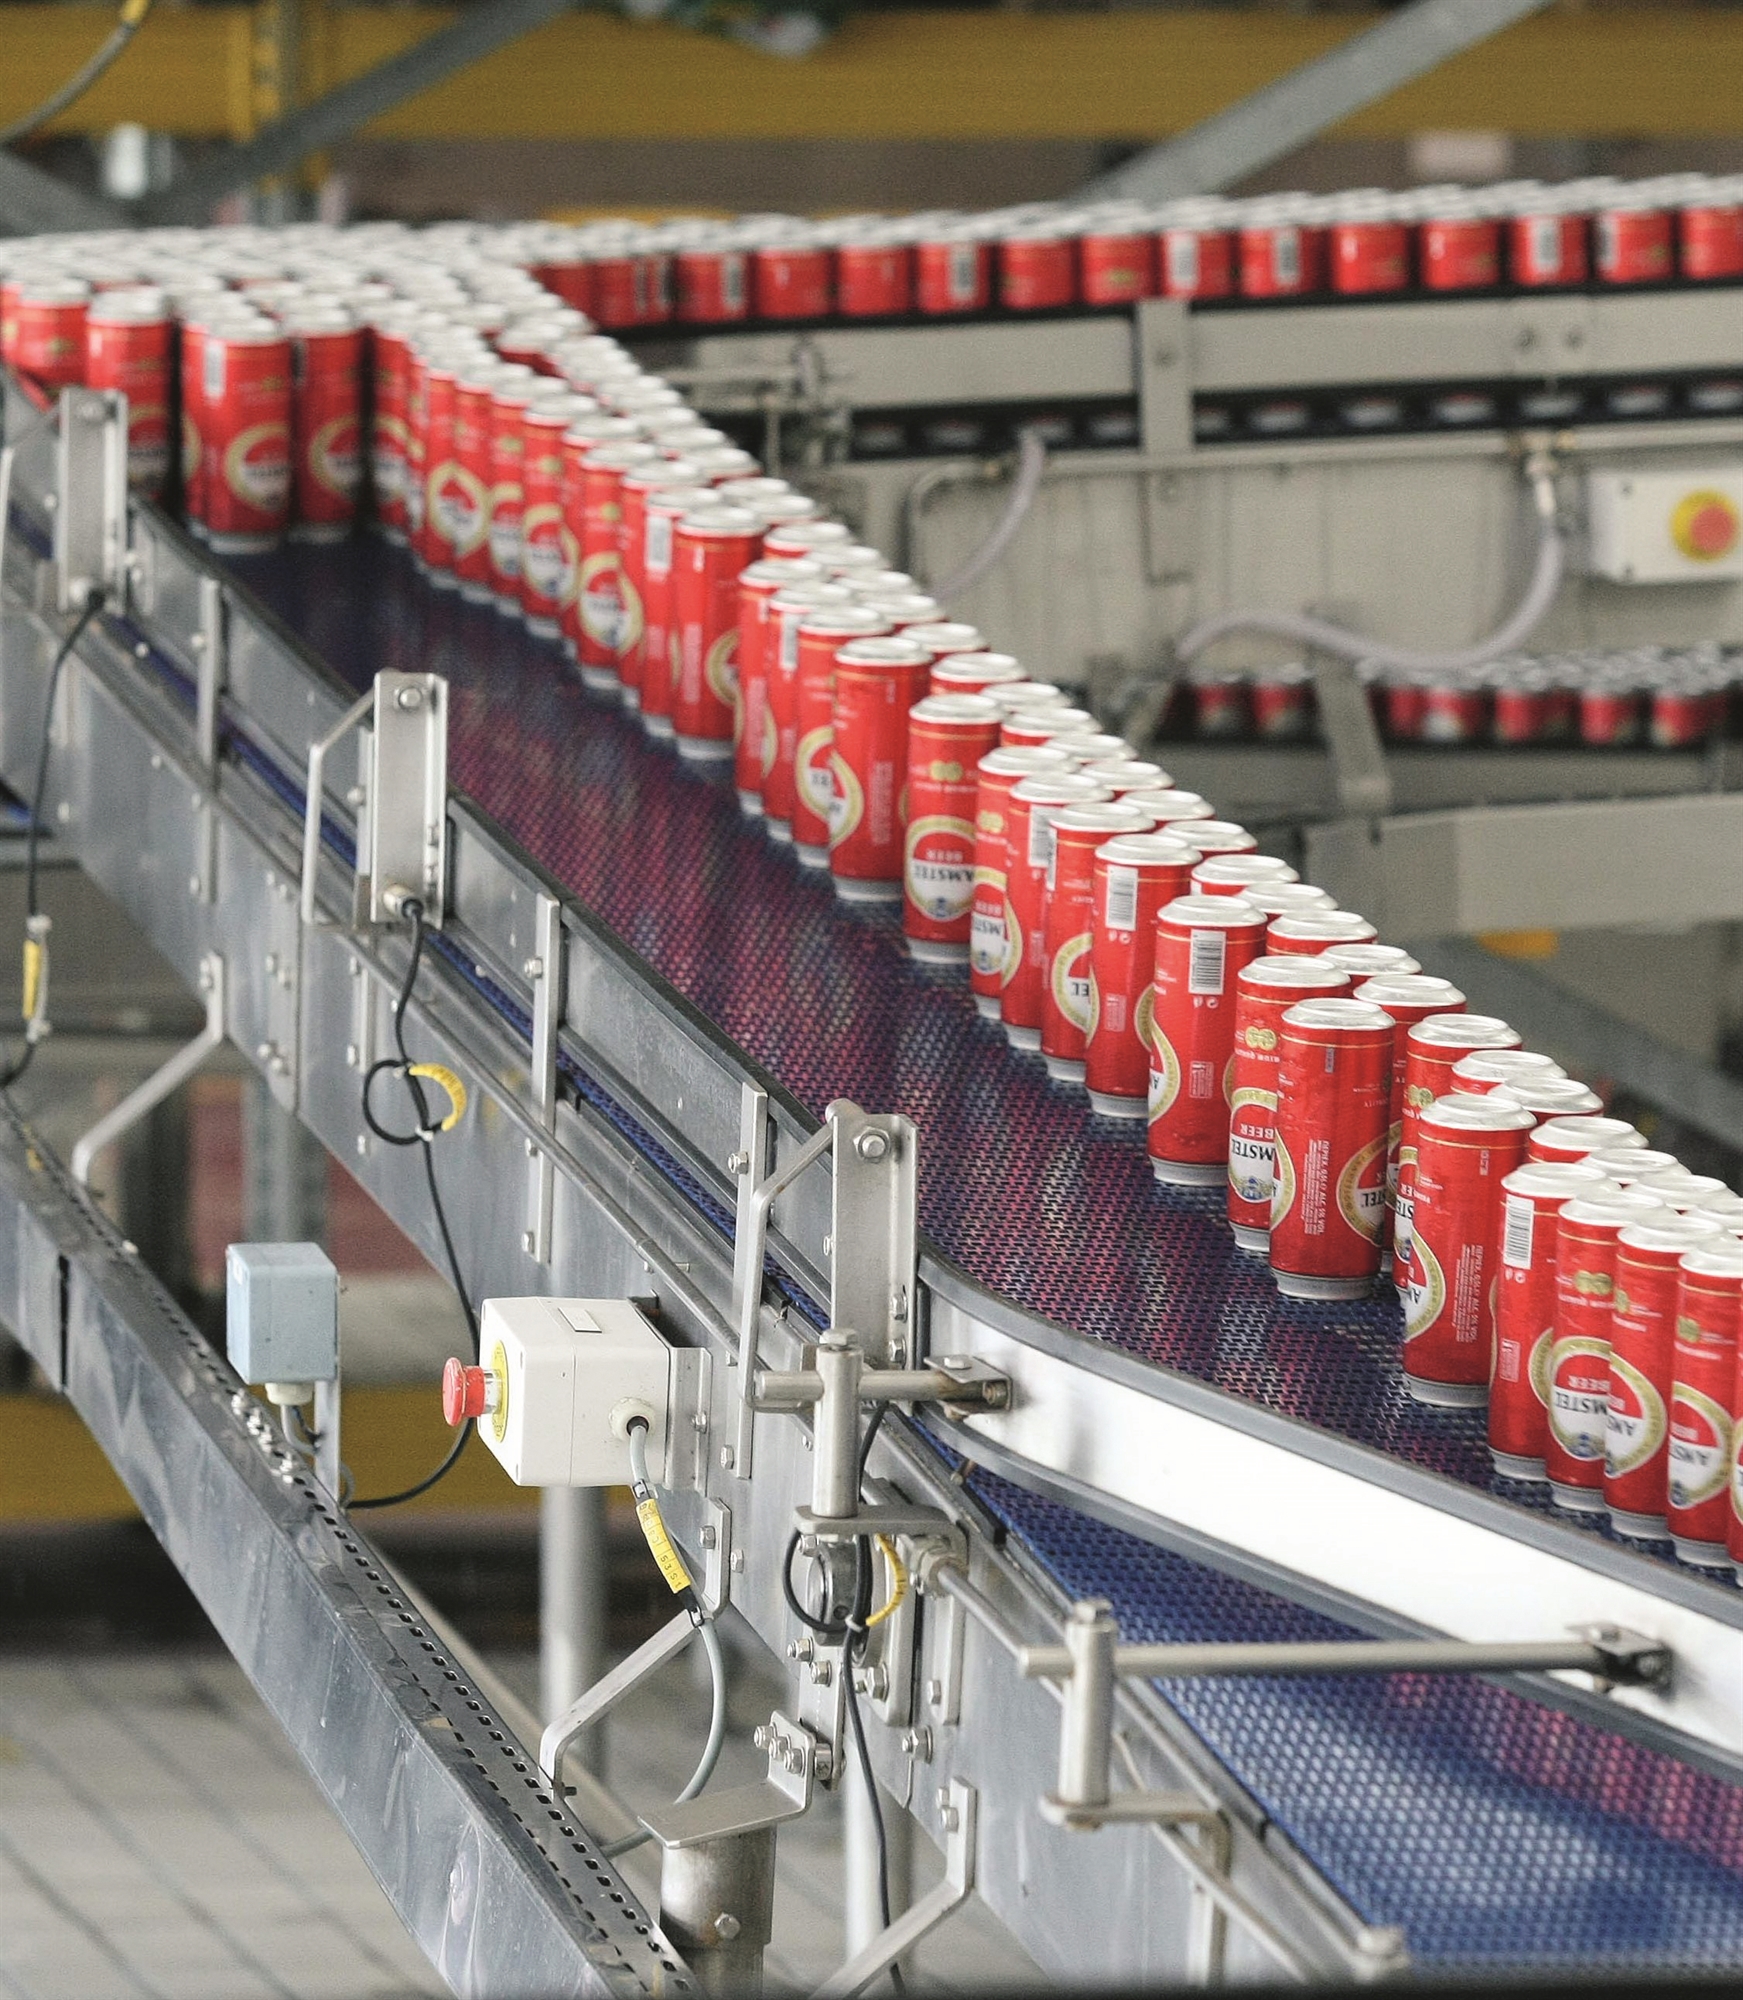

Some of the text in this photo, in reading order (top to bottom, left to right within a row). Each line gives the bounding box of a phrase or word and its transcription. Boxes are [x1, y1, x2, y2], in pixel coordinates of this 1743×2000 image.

[1239, 1122, 1274, 1139] BEER
[1230, 1138, 1275, 1161] MSTEL
[1555, 1391, 1607, 1415] MSTEL
